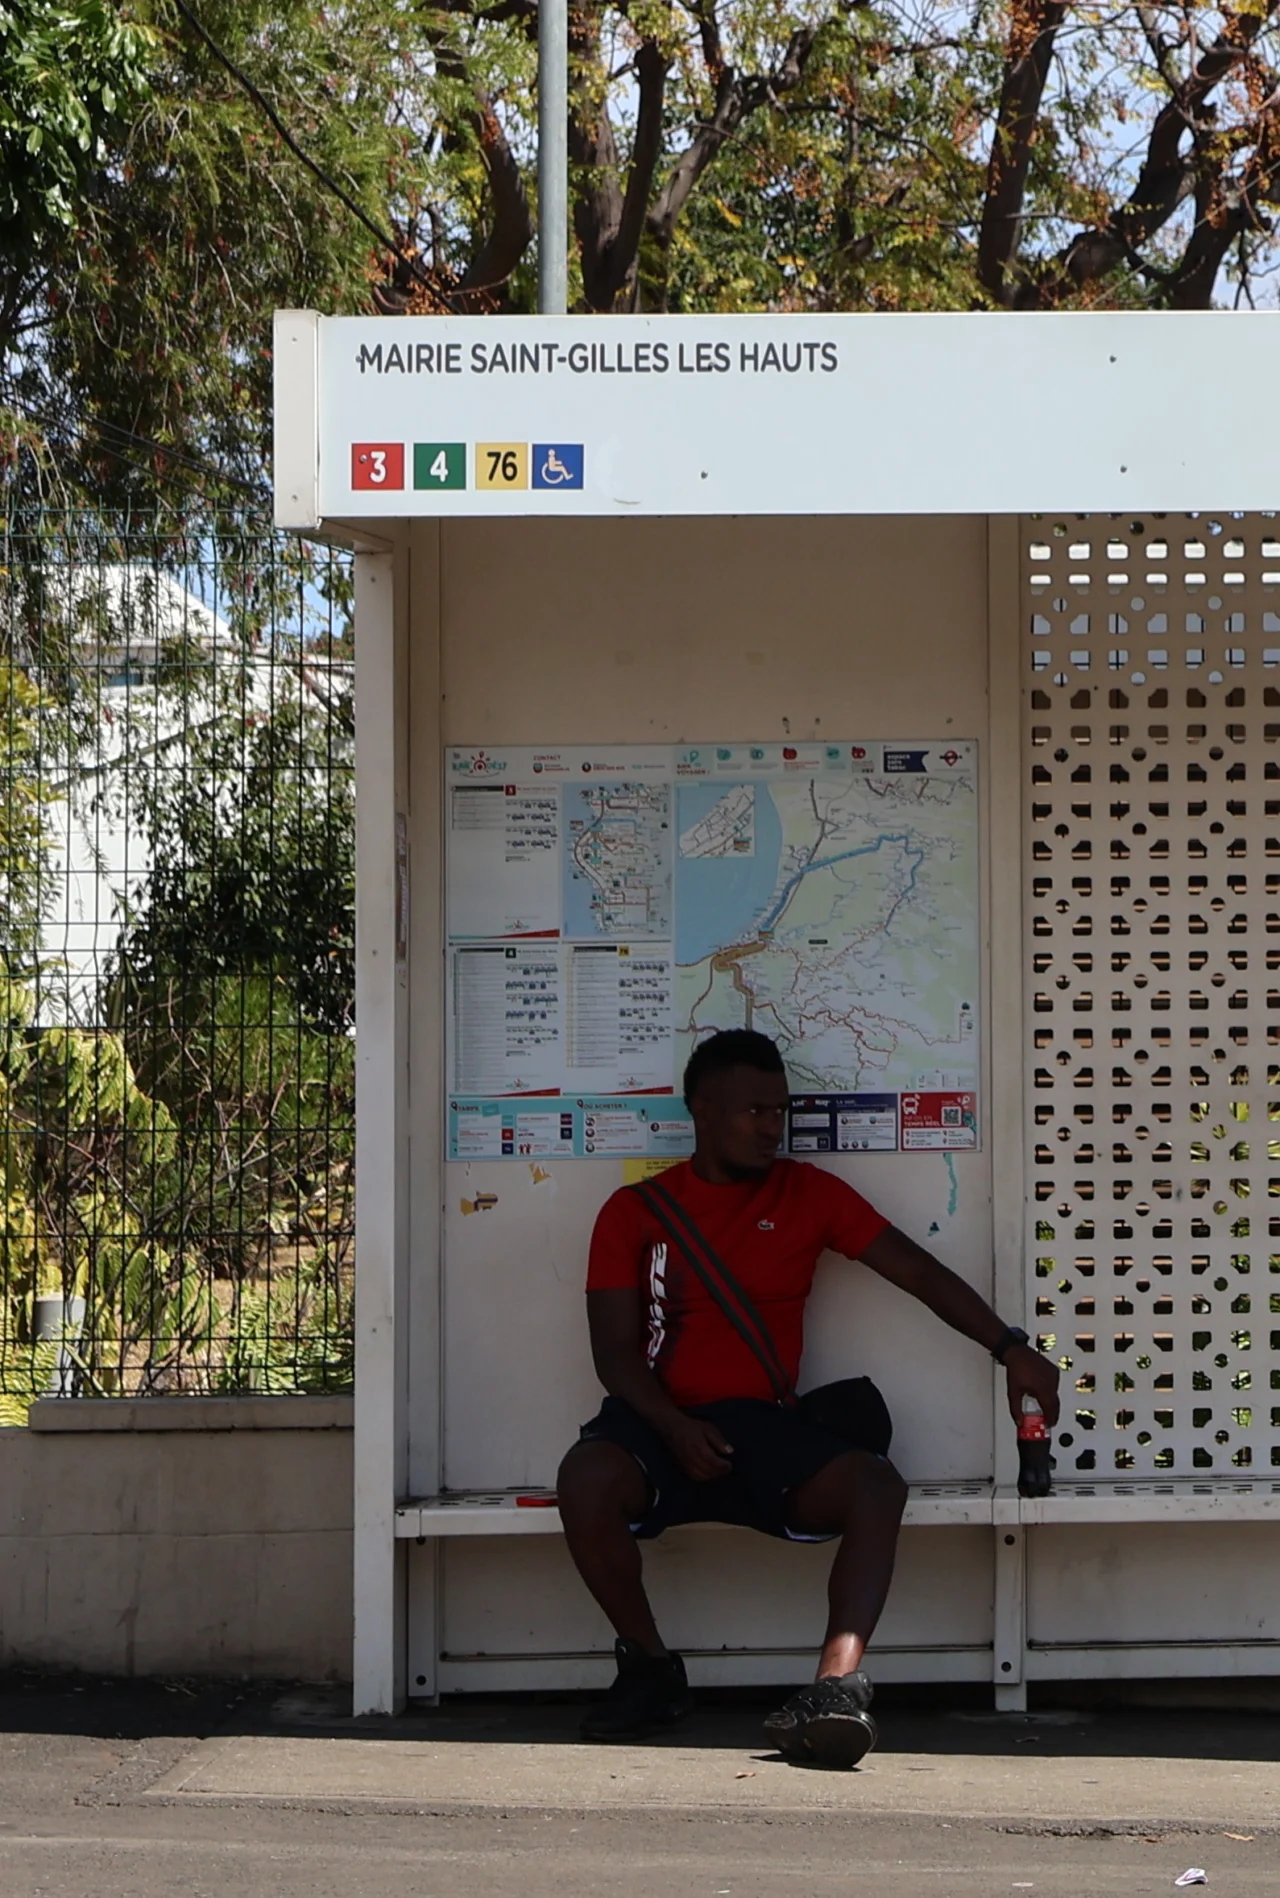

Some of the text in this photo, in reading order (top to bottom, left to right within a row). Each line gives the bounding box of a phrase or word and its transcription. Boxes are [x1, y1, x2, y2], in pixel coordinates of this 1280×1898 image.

[360, 342, 837, 373] MAIRIE SAINT-GILLES LES HAUTS
[369, 451, 385, 484] 3
[430, 450, 448, 483] 4
[486, 451, 517, 482] 76
